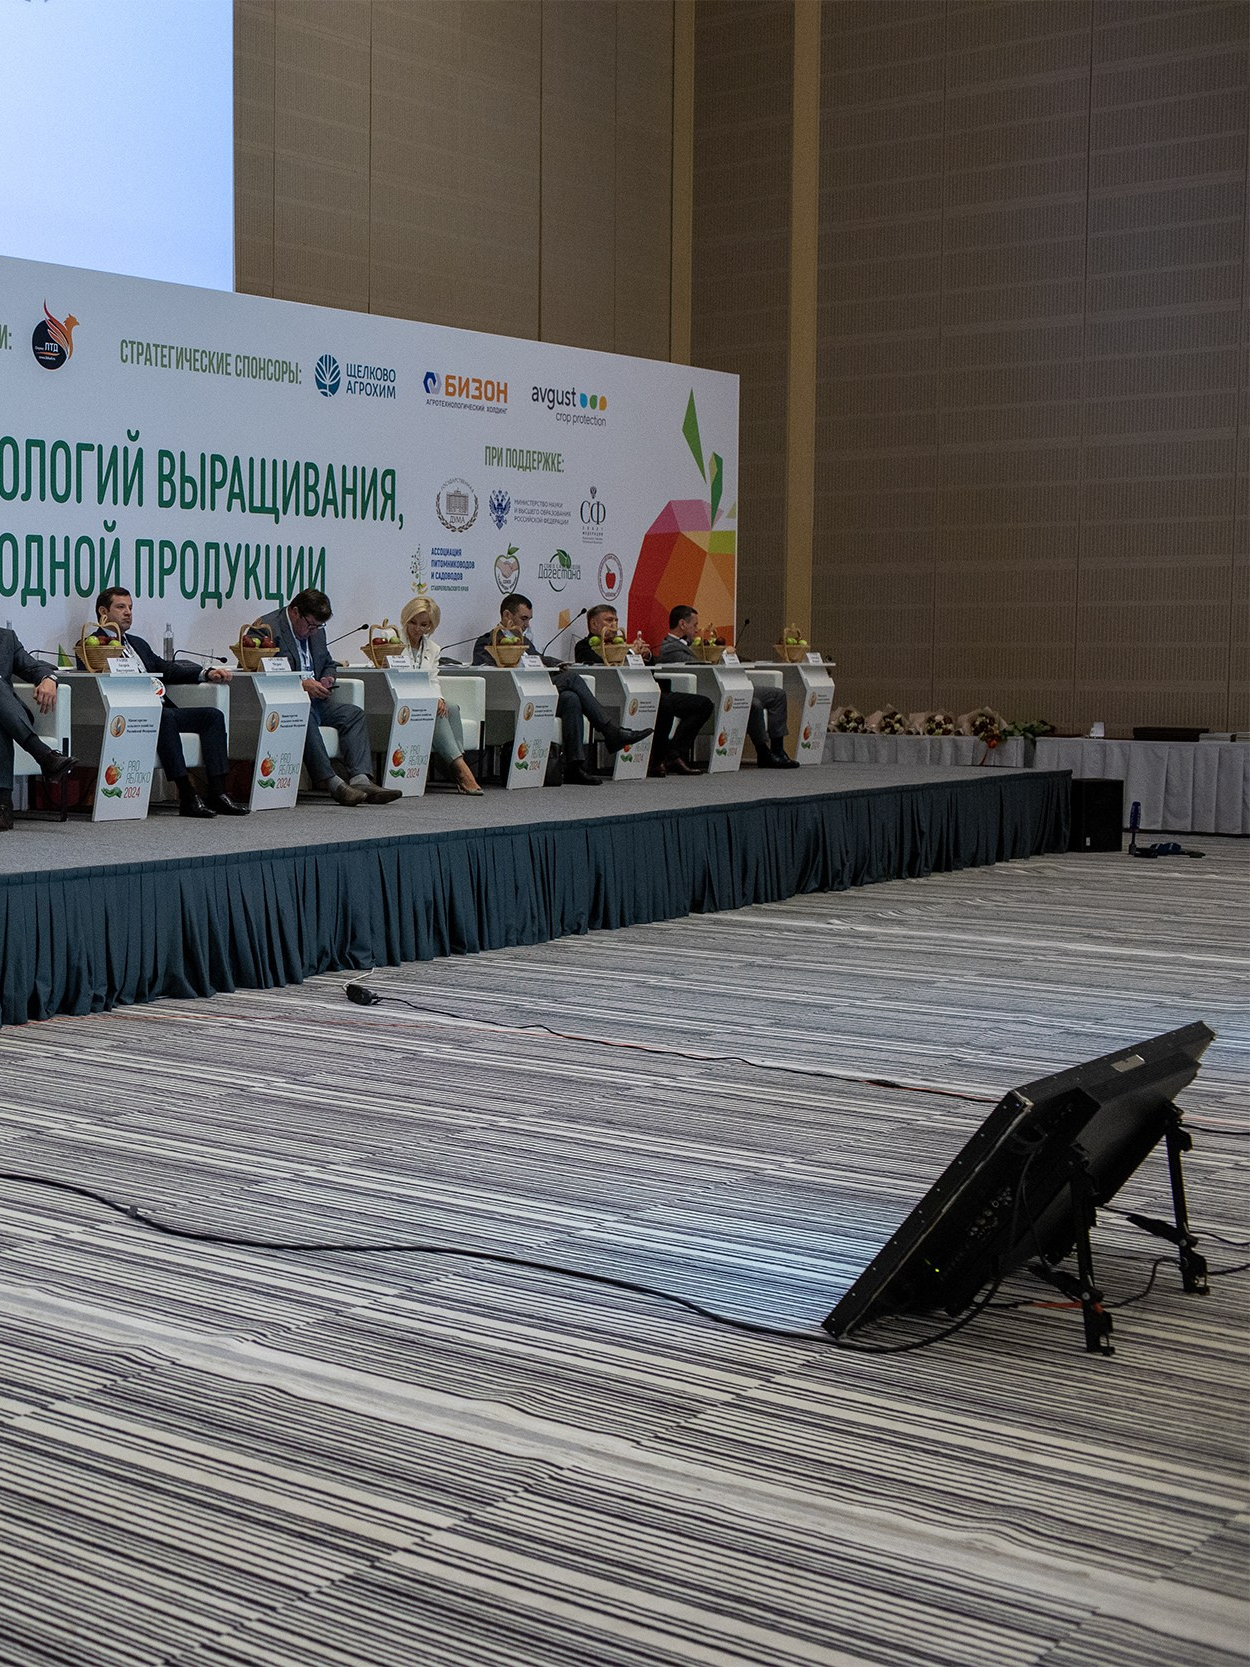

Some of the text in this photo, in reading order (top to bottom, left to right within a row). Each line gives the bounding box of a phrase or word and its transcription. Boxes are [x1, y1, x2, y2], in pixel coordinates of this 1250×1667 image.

[120, 338, 302, 385] СТРАТЕГИЧЕСКИЕ СПОНСОРЫ:
[346, 363, 397, 383] ЩЕЛКОВО
[345, 380, 397, 400] АГРОХИМ
[444, 374, 508, 404] БИЗОН
[531, 385, 577, 411] avgust
[555, 411, 607, 427] crop protection
[484, 445, 565, 473] ПРИ ПОДДЕРЖКЕ:
[156, 449, 405, 531] ВЫРАЩИВАНИЯ,
[580, 500, 607, 525] СФ
[431, 547, 462, 557] АССОЦИАЦИЯ
[134, 538, 327, 610] ПРОДУКЦИИ
[431, 559, 475, 570] ПИТОМНИКОВОДОВ
[538, 563, 581, 580] Дагестана
[276, 777, 292, 789] 2024
